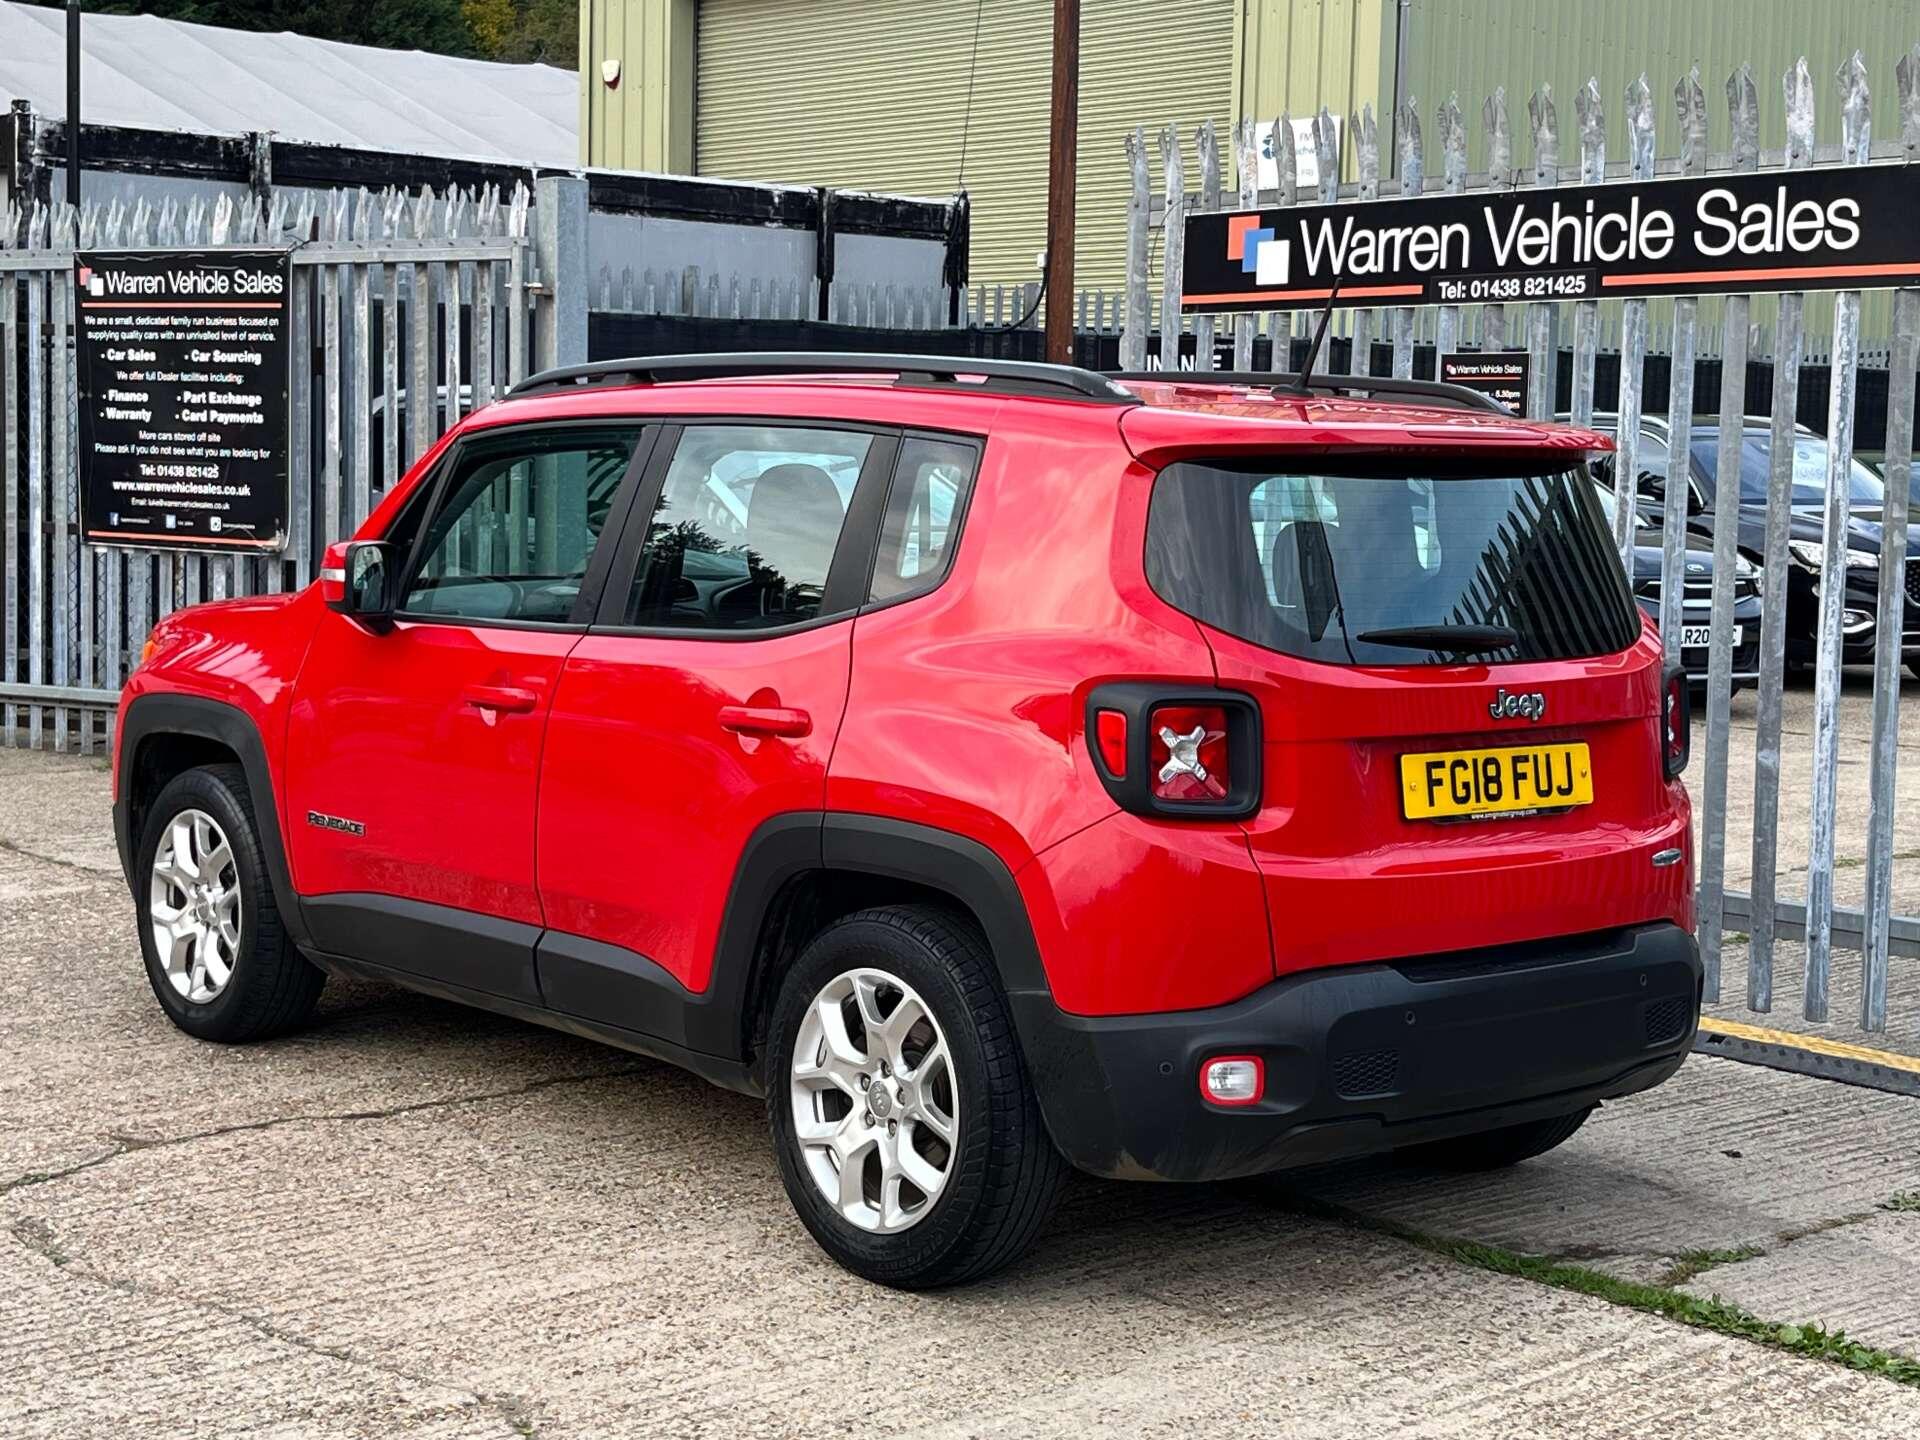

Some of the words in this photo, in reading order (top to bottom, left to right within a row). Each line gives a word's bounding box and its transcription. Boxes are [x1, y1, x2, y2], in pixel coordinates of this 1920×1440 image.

[1299, 216, 1470, 276] Warren
[1483, 196, 1675, 266] Vehicle
[1693, 185, 1860, 256] Sales
[105, 270, 165, 294] Warren
[168, 270, 229, 294] Vehicle
[234, 269, 283, 294] Sales
[1438, 281, 1467, 299] Tel:
[1470, 278, 1520, 298] 01438
[1524, 275, 1586, 296] 821425
[84, 315, 96, 325] We
[97, 317, 108, 325] are
[109, 317, 114, 325] a
[135, 316, 170, 326] dedicated
[170, 316, 191, 327] family
[192, 317, 205, 326] run
[206, 316, 238, 326] business
[238, 317, 268, 326] focused
[269, 318, 279, 326] on
[87, 330, 119, 342] supplying
[120, 330, 143, 342] quality
[143, 332, 159, 340] cars
[160, 330, 175, 340] with
[176, 332, 185, 340] an
[186, 331, 220, 341] unrivalled
[221, 331, 238, 341] level
[239, 331, 247, 341] of
[247, 331, 276, 341] service.
[107, 348, 126, 361] Car
[127, 348, 157, 361] Sales
[191, 348, 211, 362] Car
[212, 349, 262, 366] Sourcing
[116, 370, 128, 380] We
[129, 370, 144, 380] offer
[145, 371, 157, 381] full
[157, 371, 179, 381] Dealer
[180, 371, 209, 382] facilities
[1456, 365, 1480, 374] Warren
[1480, 365, 1503, 374] Vehicle
[1504, 364, 1523, 374] Sales
[108, 389, 149, 402] Finance
[183, 390, 207, 404] Part
[208, 391, 262, 407] Exchange
[105, 407, 152, 422] Warranty
[182, 408, 207, 422] Card
[209, 410, 264, 425] Payments
[138, 430, 157, 440] More
[157, 432, 173, 441] cars
[173, 432, 196, 442] stored
[196, 432, 207, 442] off
[207, 432, 221, 442] site
[95, 443, 117, 453] Please
[117, 444, 130, 453] ask
[130, 443, 136, 453] if
[136, 446, 149, 456] you
[149, 445, 160, 455] do
[160, 446, 172, 455] not
[172, 447, 186, 456] see
[186, 447, 204, 457] what
[205, 449, 219, 458] you
[219, 449, 232, 458] are
[232, 448, 259, 461] looking
[259, 448, 271, 459] for
[140, 464, 156, 476] Tel:
[156, 465, 184, 478] 01438
[185, 465, 219, 479] 821425
[112, 481, 251, 497] www.warrenvehiclesales.co.uk
[1680, 628, 1710, 645] R20
[1489, 688, 1546, 721] Jeep
[1425, 756, 1503, 808] FG18
[1511, 751, 1575, 801] FUJ
[306, 809, 368, 837] RENEGADE
